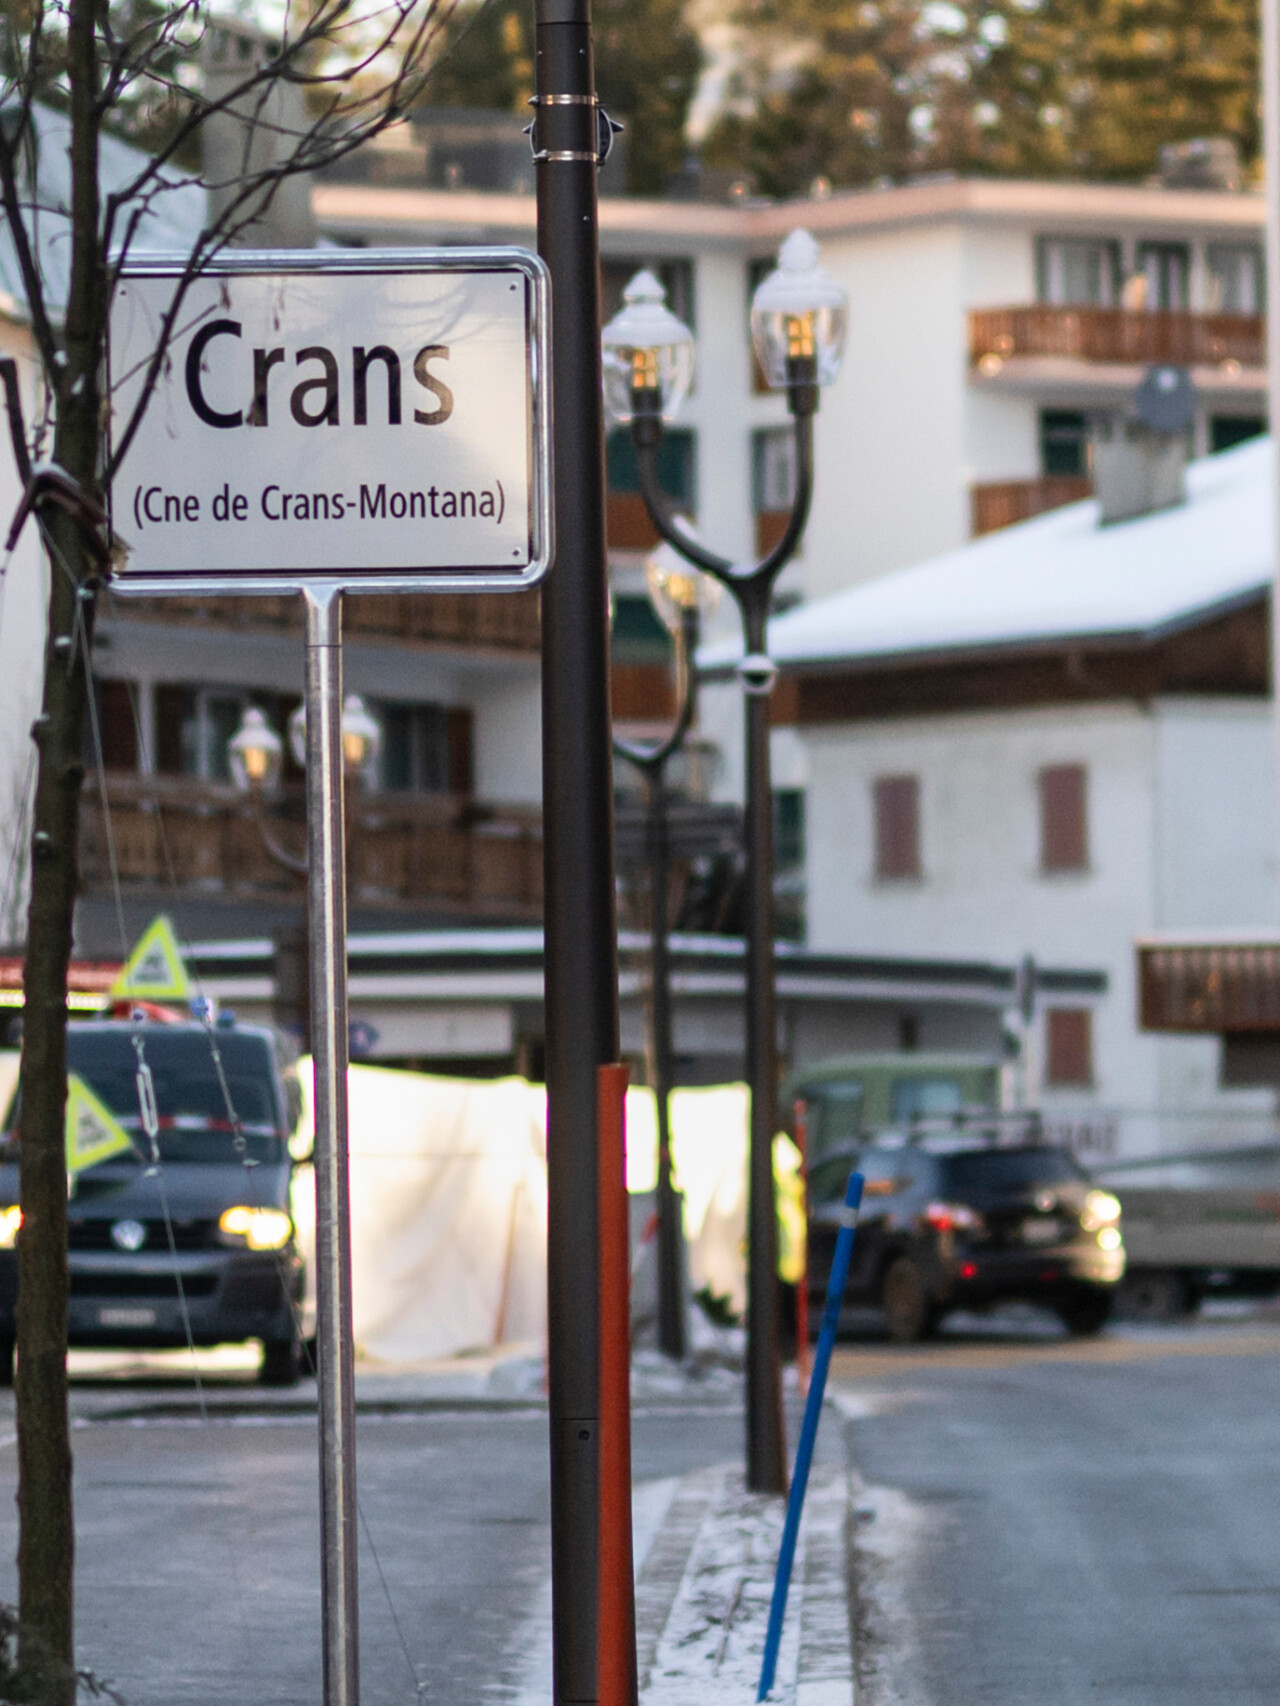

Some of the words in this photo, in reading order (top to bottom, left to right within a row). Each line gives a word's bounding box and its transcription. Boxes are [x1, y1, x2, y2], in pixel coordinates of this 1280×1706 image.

[184, 318, 454, 429] Crans
[133, 485, 200, 530] (Cne
[212, 483, 249, 522] de
[261, 479, 506, 524] Crans-Montana)
